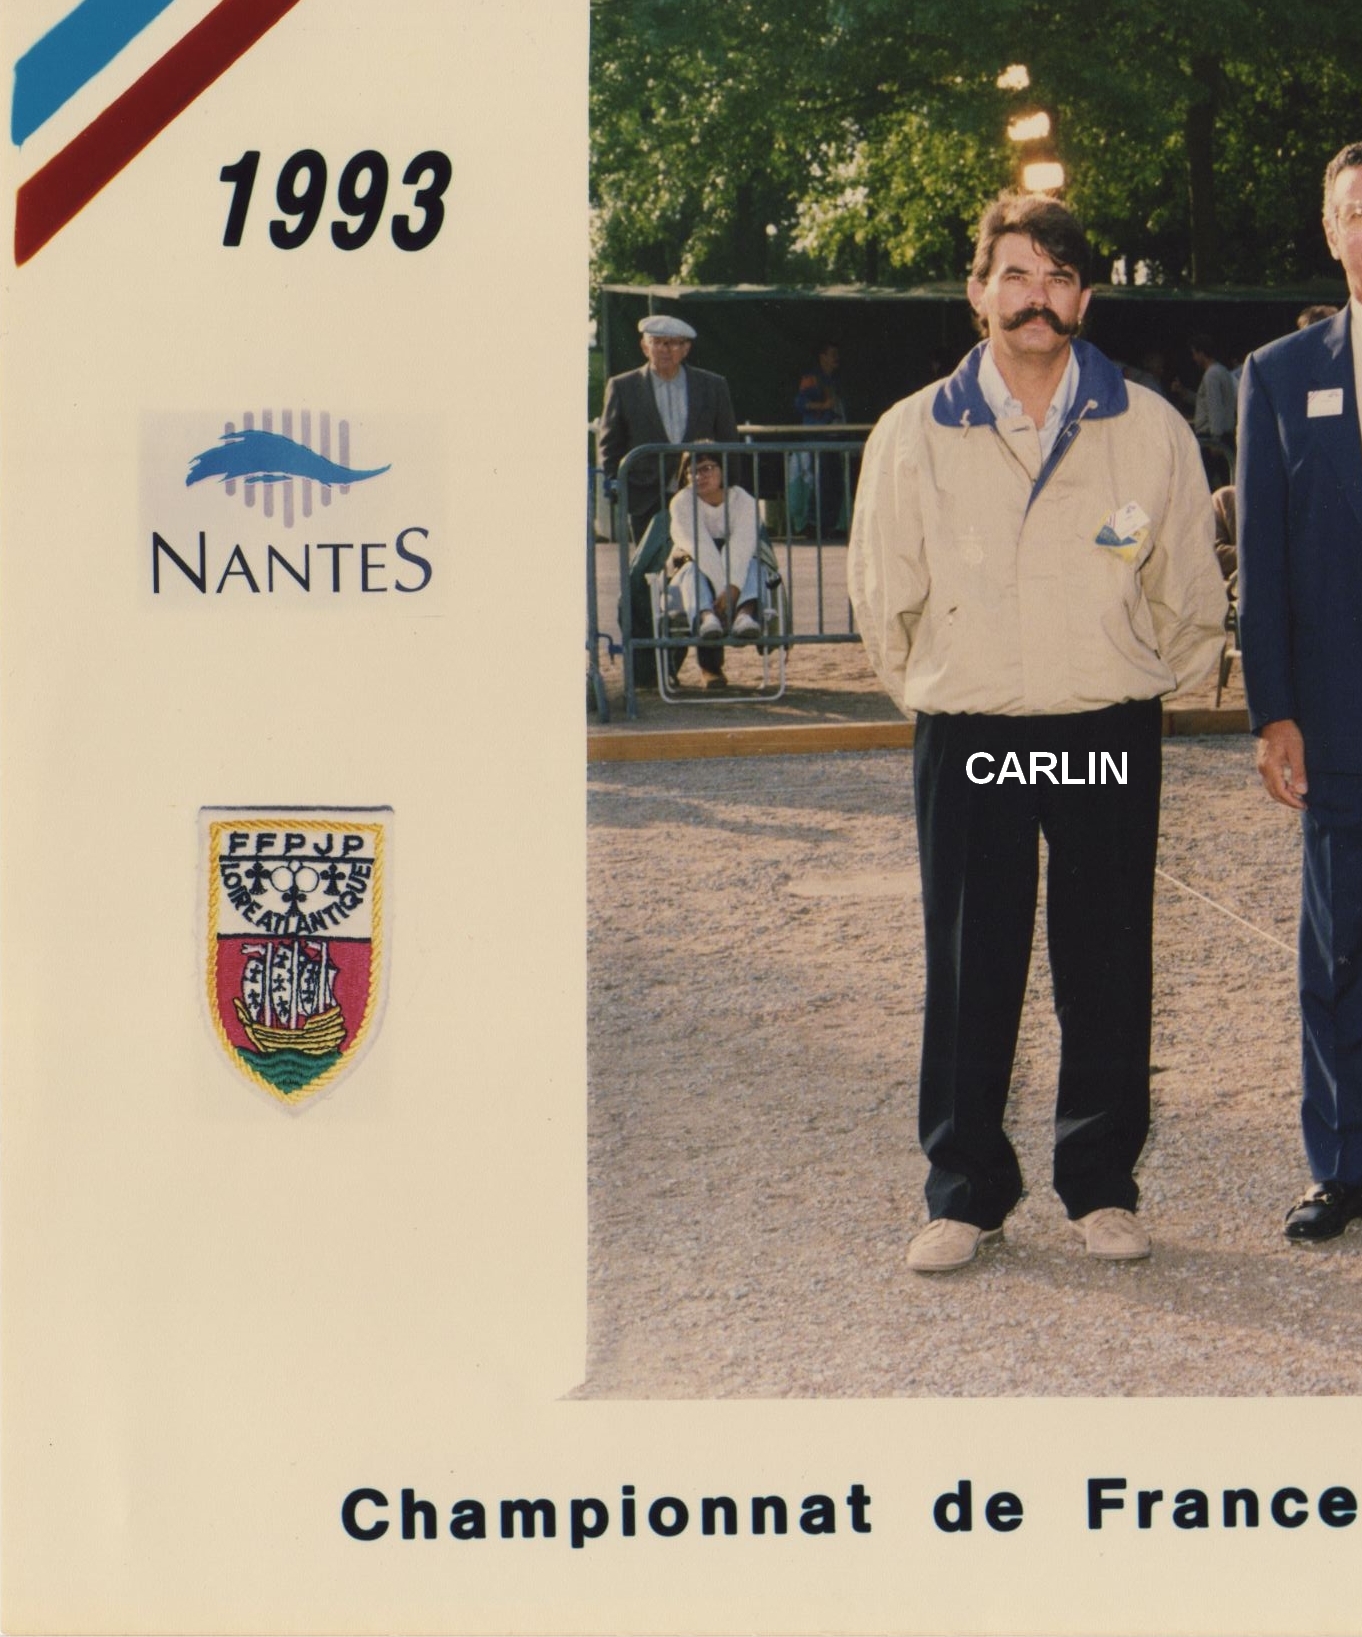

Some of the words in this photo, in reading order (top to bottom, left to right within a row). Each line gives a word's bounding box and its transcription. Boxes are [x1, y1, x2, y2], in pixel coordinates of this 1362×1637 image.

[219, 148, 453, 252] 1993
[228, 831, 365, 857] FFPJP
[341, 1484, 872, 1549] Championnat
[933, 1479, 1024, 1533] de
[1087, 1477, 1358, 1530] France
